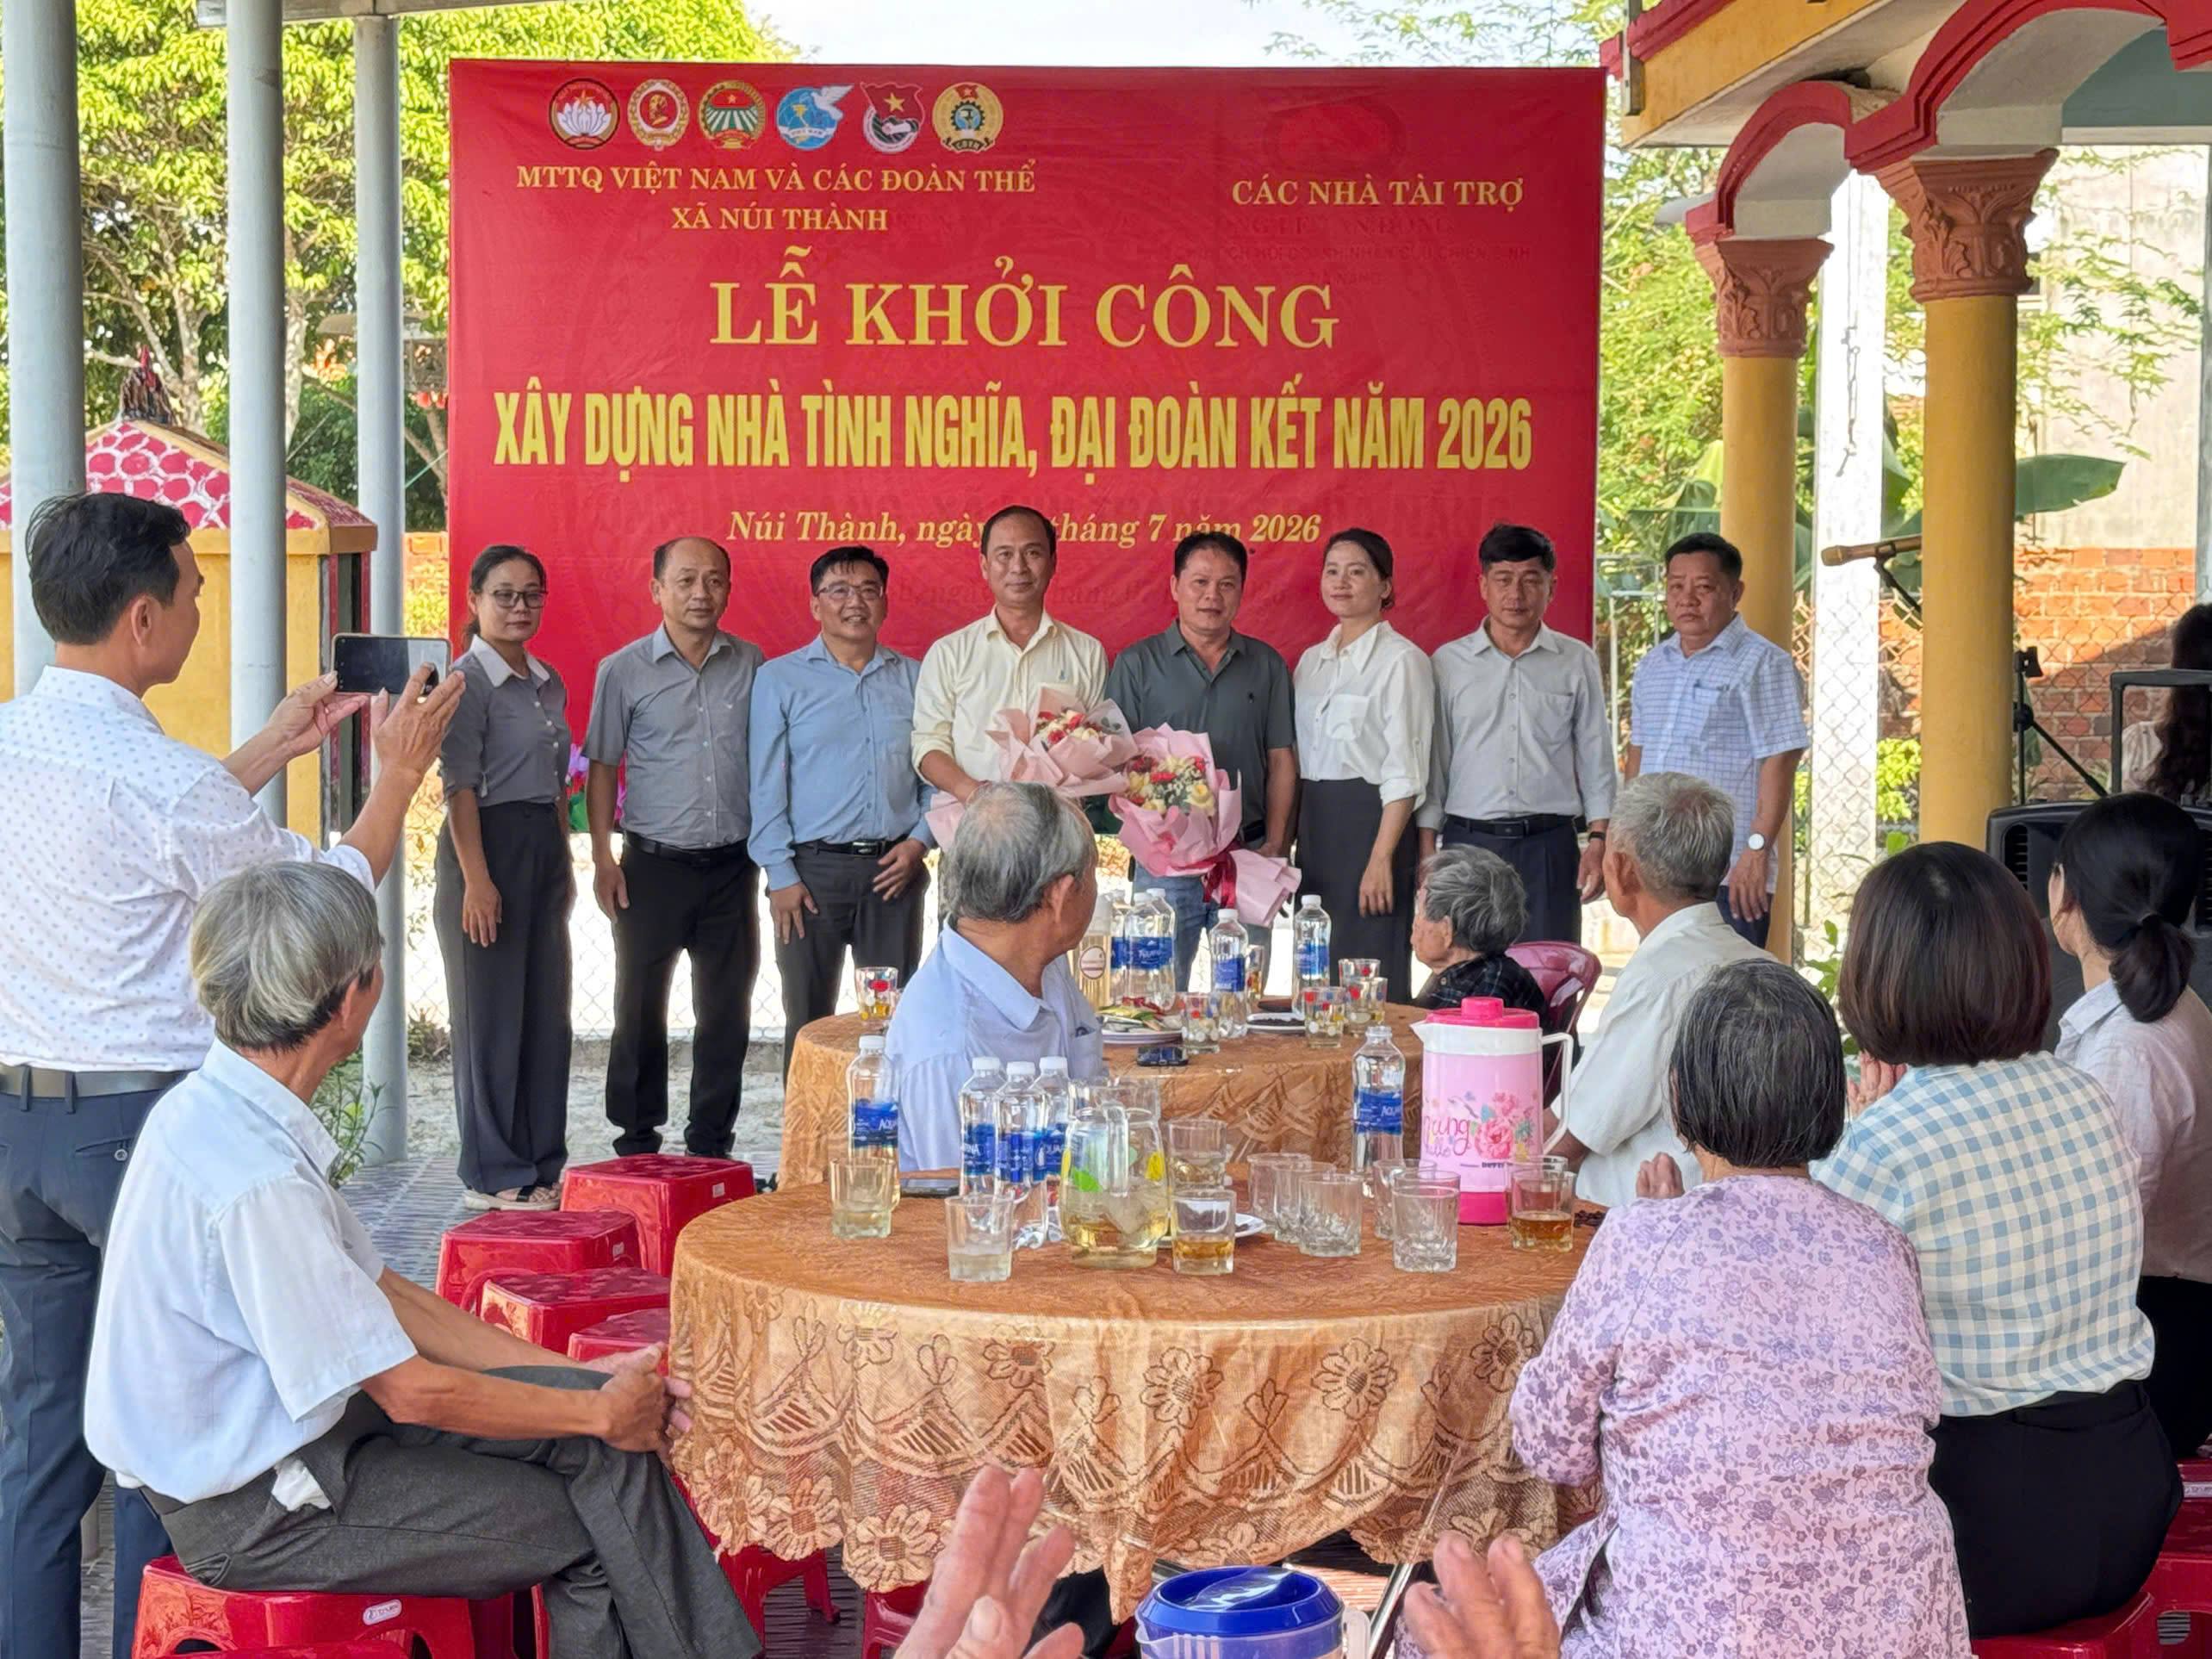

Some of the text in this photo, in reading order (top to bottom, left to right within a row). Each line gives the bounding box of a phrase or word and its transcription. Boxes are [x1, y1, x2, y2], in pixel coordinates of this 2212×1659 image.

[516, 158, 1037, 196] MTTQ VIỆT NAM VÀ CÁC ĐOÀN THỂ
[1232, 174, 1525, 213] CÁC NHÀ TÀI TRỢ
[671, 200, 889, 231] XÃ NÚI THÀNH
[710, 245, 1339, 349] LỄ KHỞI CÔNG
[493, 373, 1532, 485] XÂY DỰNG NHÀ TÌNH NGHĨA, ĐẠI ĐOÀN KẾT NĂM 2026
[728, 511, 786, 542] Núi
[797, 511, 907, 548] Thành,
[1148, 513, 1168, 543] 7
[1250, 513, 1322, 543] 2026
